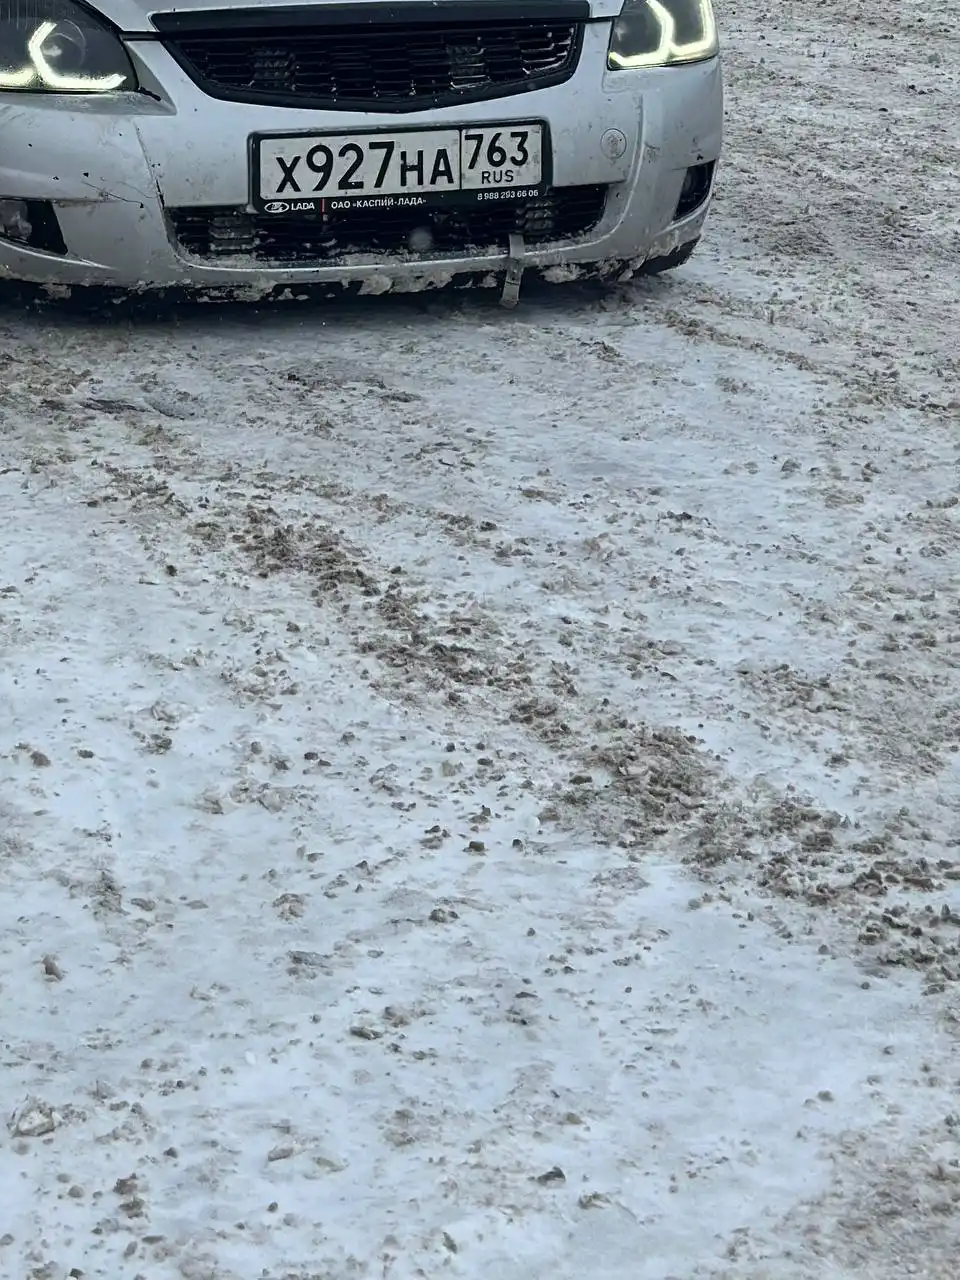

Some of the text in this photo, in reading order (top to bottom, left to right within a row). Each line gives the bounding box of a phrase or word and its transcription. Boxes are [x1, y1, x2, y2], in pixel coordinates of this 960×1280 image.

[275, 131, 529, 193] Х927НА 763
[481, 169, 514, 185] RUS
[291, 202, 315, 211] LADA
[331, 200, 351, 209] ОАО
